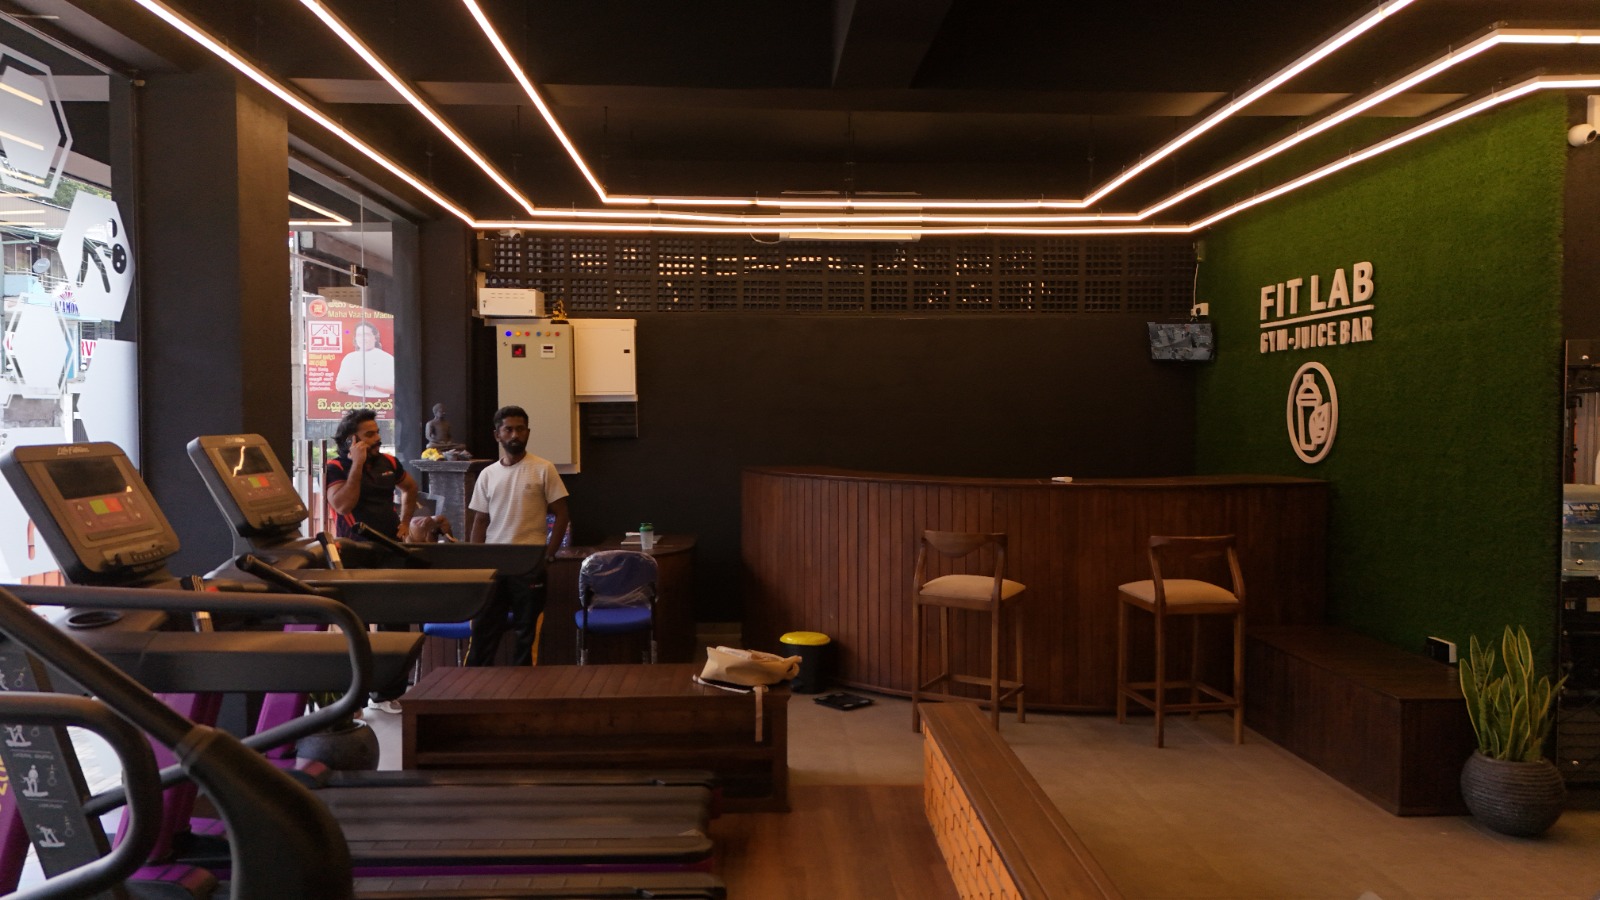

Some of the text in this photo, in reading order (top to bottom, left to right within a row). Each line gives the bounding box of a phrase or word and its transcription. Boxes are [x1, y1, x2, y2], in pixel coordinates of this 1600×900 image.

[1260, 261, 1374, 320] FIT LAB
[311, 336, 340, 347] DU
[1340, 316, 1373, 345] BAR
